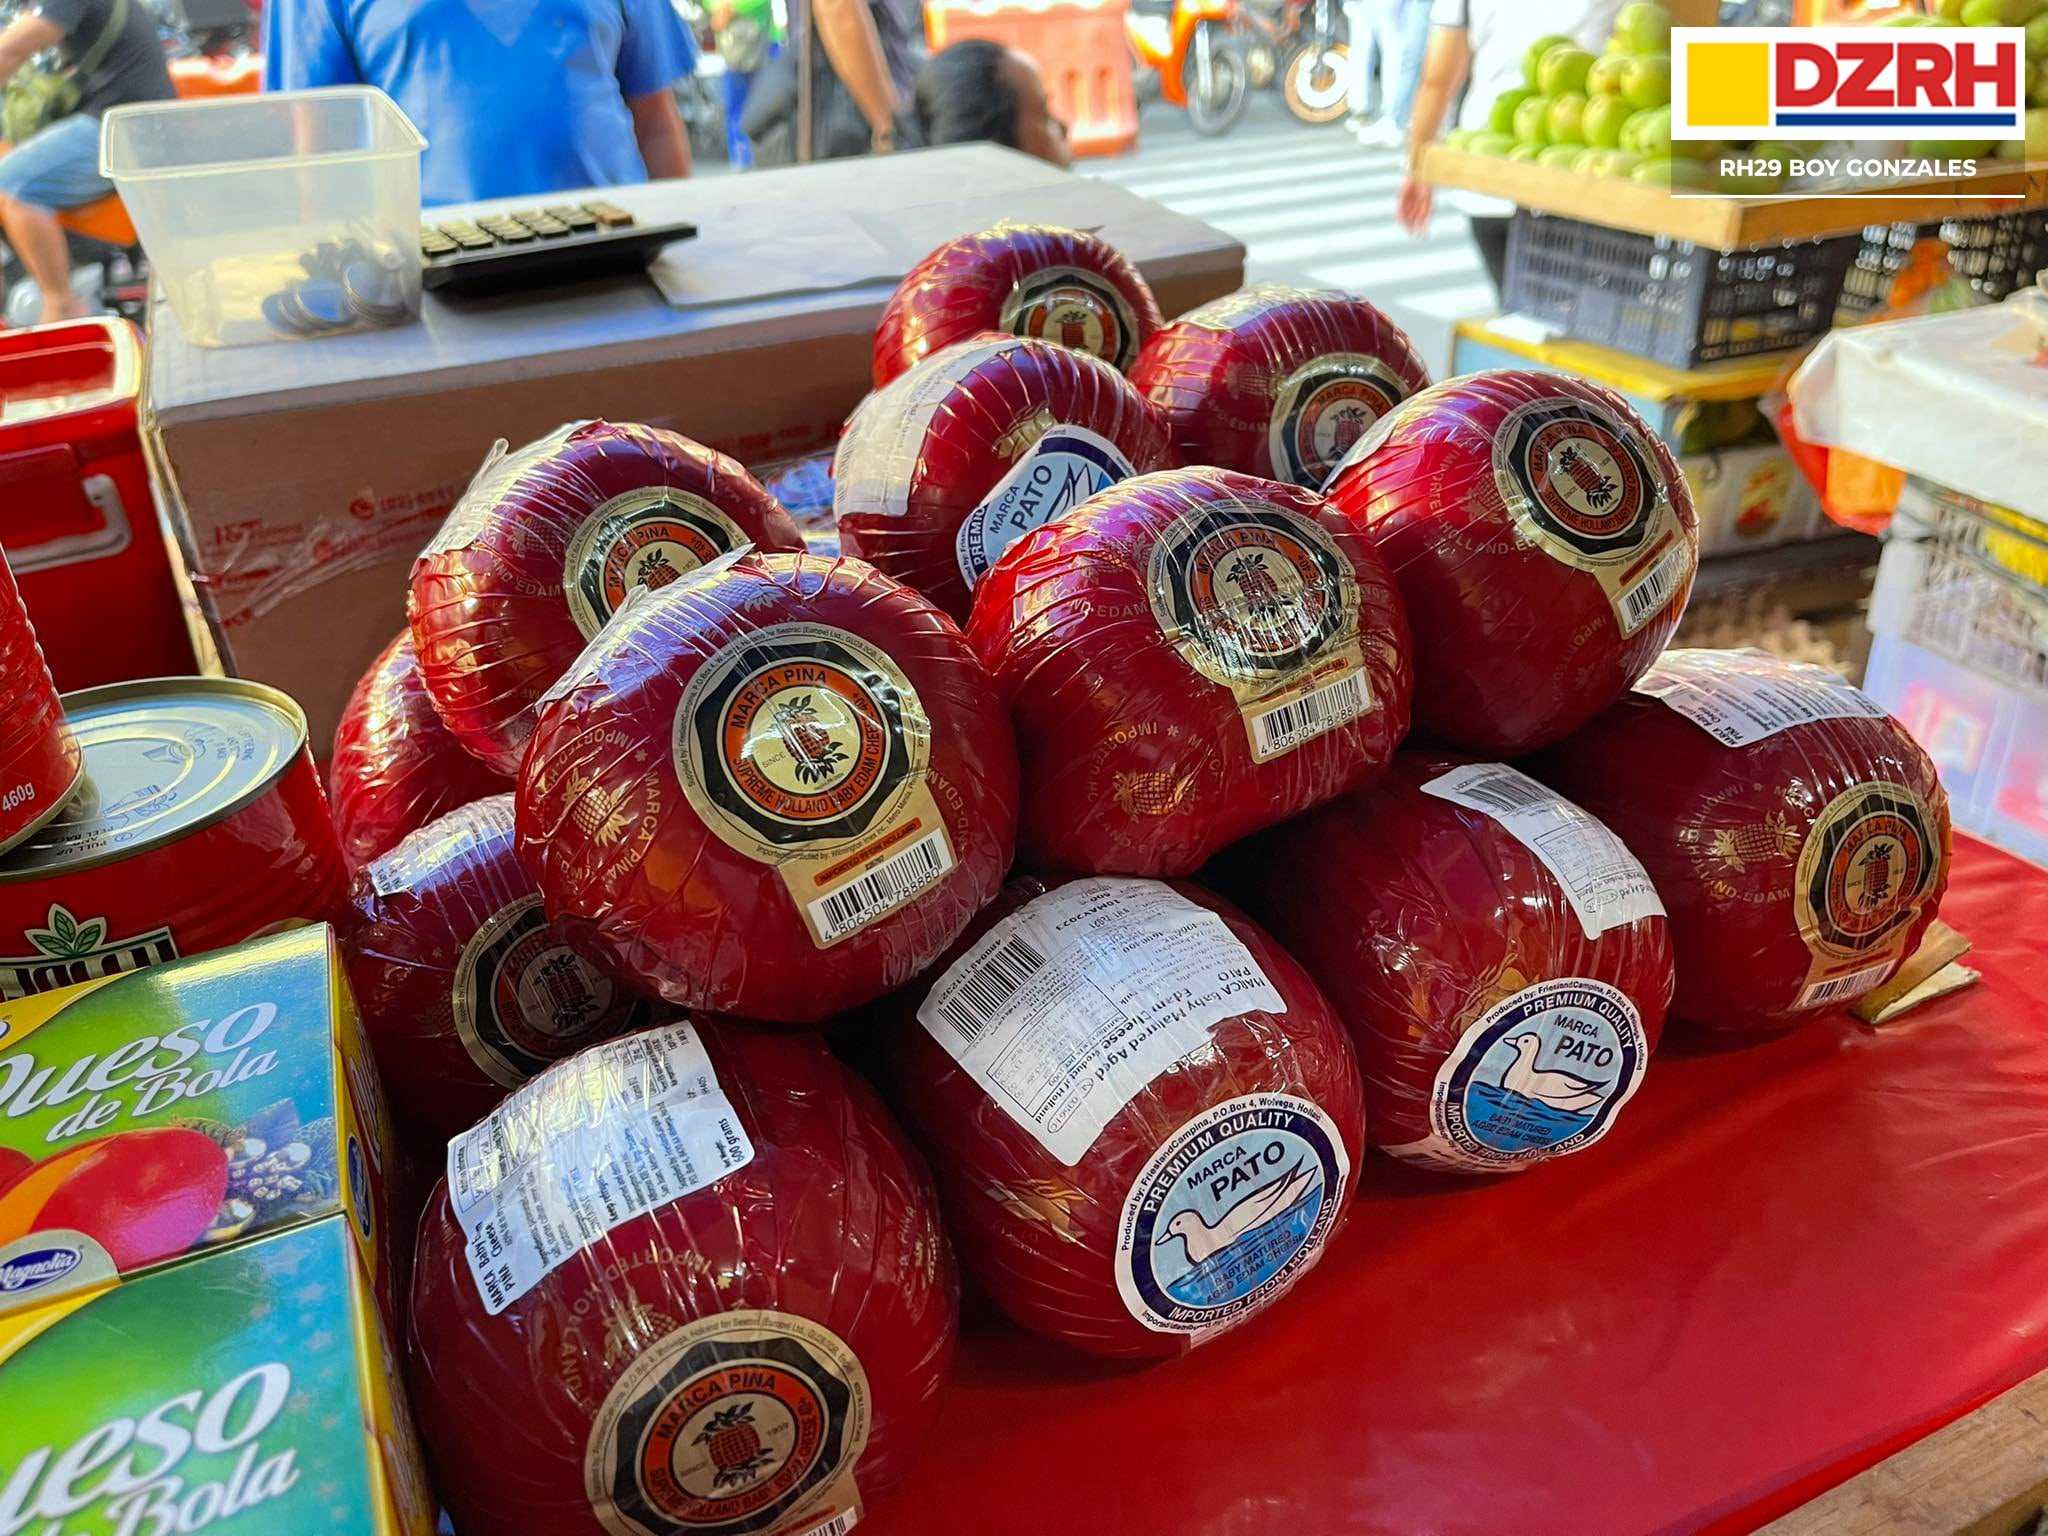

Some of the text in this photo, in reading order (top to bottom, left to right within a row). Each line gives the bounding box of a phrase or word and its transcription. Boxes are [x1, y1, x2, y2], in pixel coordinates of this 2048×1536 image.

[989, 485, 1021, 534] MARCA
[1010, 465, 1052, 531] PATO
[636, 526, 671, 541] PINA
[1098, 602, 1150, 619] EDAM
[731, 666, 827, 728] MARCA PINA
[761, 752, 788, 770] SINCE
[1, 783, 36, 813] 460g
[733, 757, 774, 804] SUPREME
[775, 795, 830, 815] HOLLAND
[854, 756, 879, 789] EDAM
[603, 770, 662, 881] MARCA PINA
[824, 930, 833, 940] 4
[838, 899, 891, 936] 806504
[893, 867, 940, 901] 788880
[1215, 964, 1251, 983] PATO
[1219, 975, 1266, 997] MARCA
[1485, 996, 1525, 1024] Produced
[1524, 990, 1538, 1001] by:
[1538, 980, 1606, 995] FrieslandCampina,
[1523, 992, 1634, 1050] PREMIUM QUALITY
[1100, 1008, 1150, 1051] Cheese
[1553, 1014, 1600, 1039] MARCA
[1067, 1048, 1100, 1080] Product
[1093, 1045, 1128, 1081] Aged
[1553, 1035, 1614, 1068] PATO
[46, 1048, 280, 1142] de Bola
[1033, 1086, 1064, 1124] Holland
[1212, 1101, 1247, 1121] P.O.Box
[717, 1115, 746, 1164] 600 grams
[1446, 1102, 1480, 1152] IMPORTED
[1478, 1146, 1516, 1161] FROM
[1517, 1133, 1586, 1161] HOAND
[1471, 1119, 1501, 1135] AGED
[1514, 1119, 1553, 1135] MATURED
[1140, 1119, 1213, 1188] FrieslandCampina,
[1143, 1112, 1295, 1214] PREMIUM QUALITY
[1186, 1145, 1248, 1190] MARCA
[1209, 1140, 1286, 1202] PATO
[603, 1201, 619, 1223] Keep
[1136, 1187, 1145, 1201] by:
[1121, 1201, 1137, 1252] Produced
[472, 1239, 506, 1308] MARCA Baby
[484, 1221, 516, 1291] PINA Cheese
[1168, 1300, 1244, 1323] IMPORTED
[1246, 1269, 1289, 1304] FROM
[1288, 1198, 1333, 1271] HOLLAND
[1214, 1229, 1292, 1287] BABY MATURED
[1206, 1280, 1234, 1302] AGED
[1236, 1260, 1266, 1283] EDAM
[656, 1383, 723, 1440] MARCA
[729, 1372, 776, 1393] PINA
[105, 1442, 301, 1536] Bola
